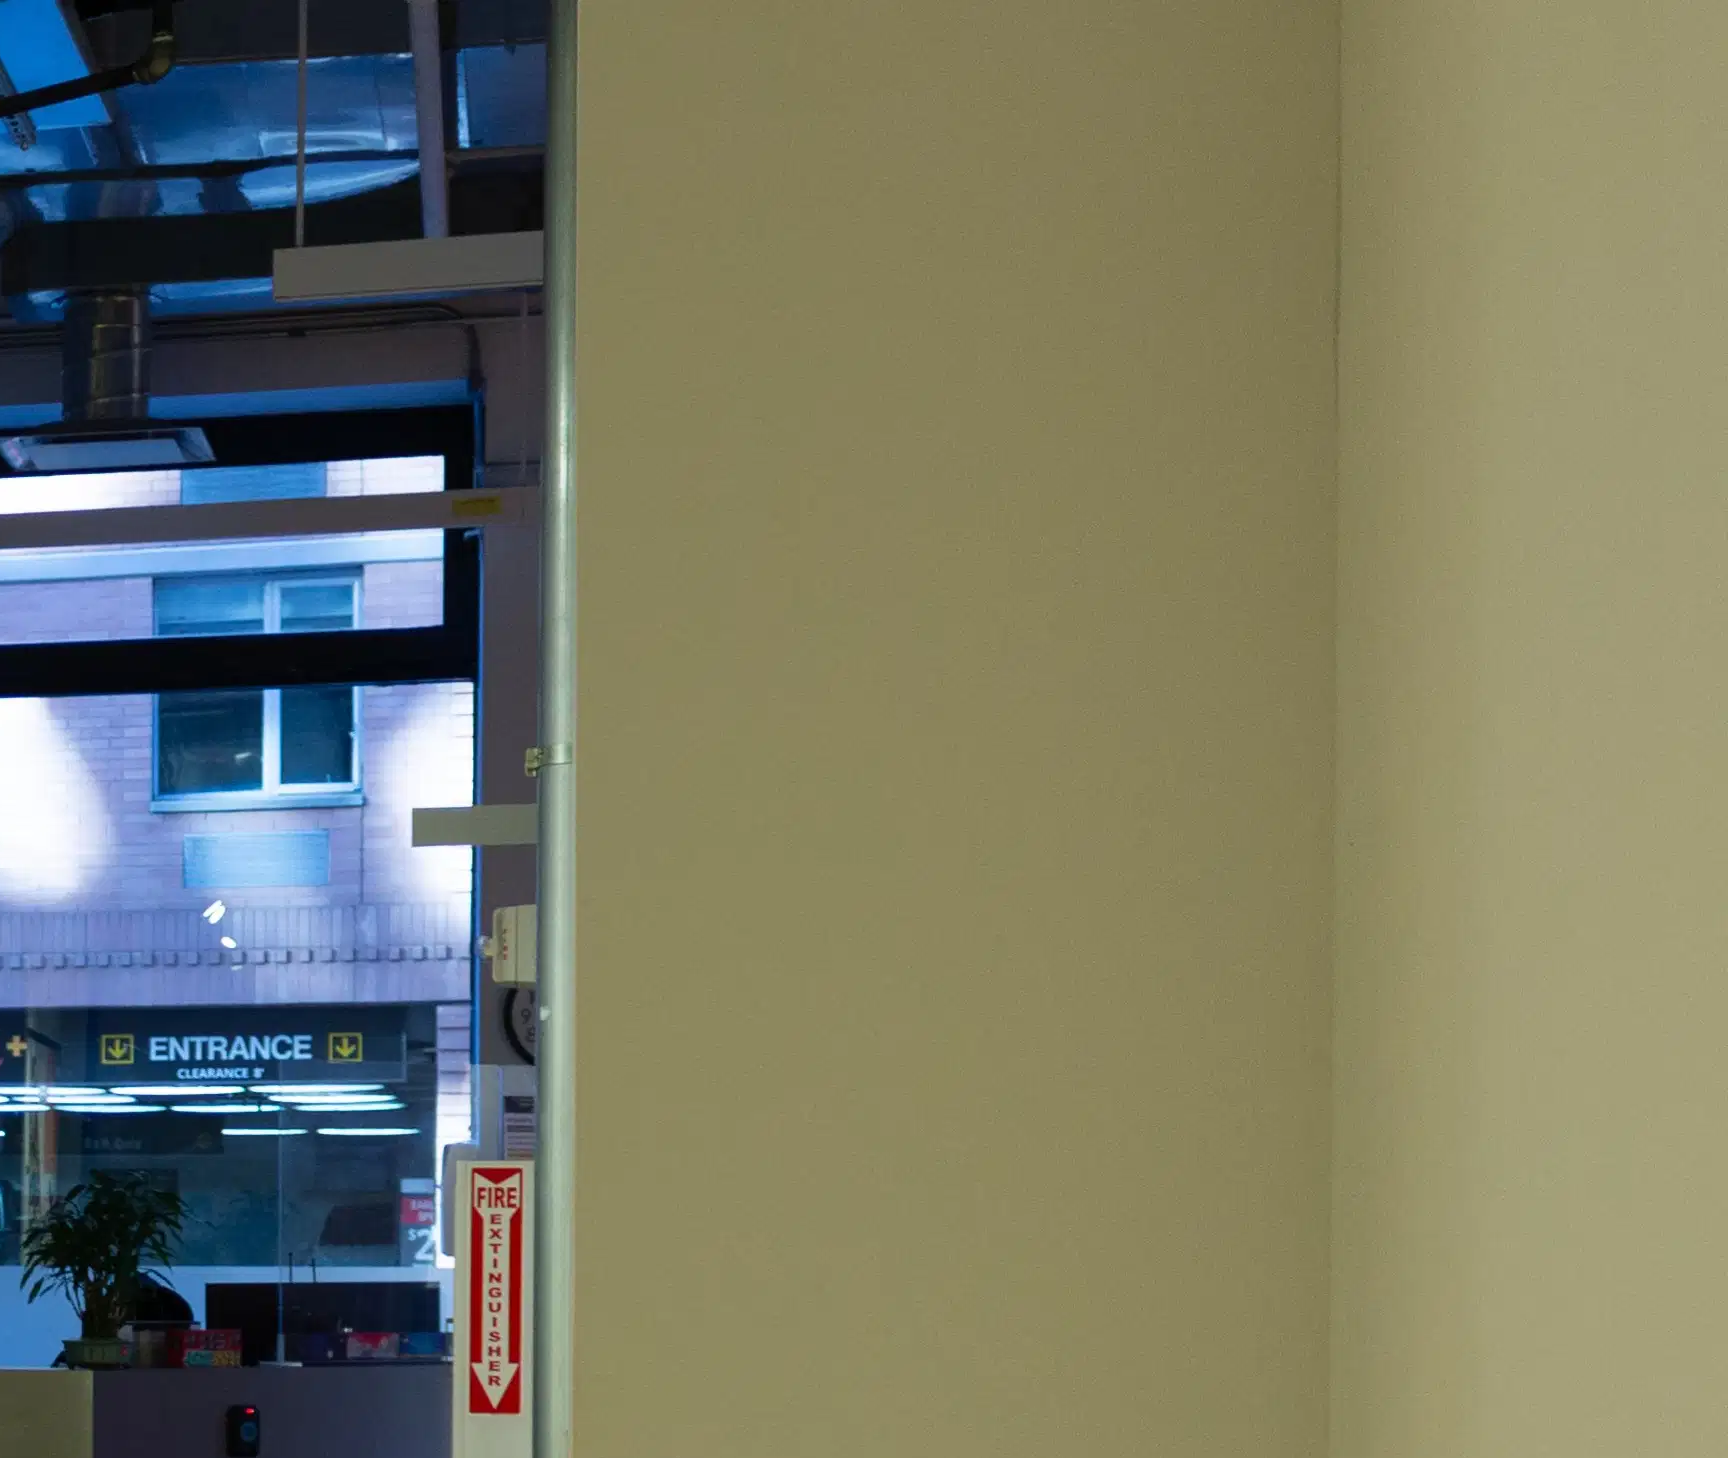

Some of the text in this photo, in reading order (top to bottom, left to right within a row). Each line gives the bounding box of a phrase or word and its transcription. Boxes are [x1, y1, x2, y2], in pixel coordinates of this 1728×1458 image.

[148, 1034, 313, 1061] ENTRANCE
[176, 1067, 250, 1079] CLEARANCE
[476, 1186, 519, 1209] FIRE
[487, 1213, 503, 1387] EXTINGUISHER
